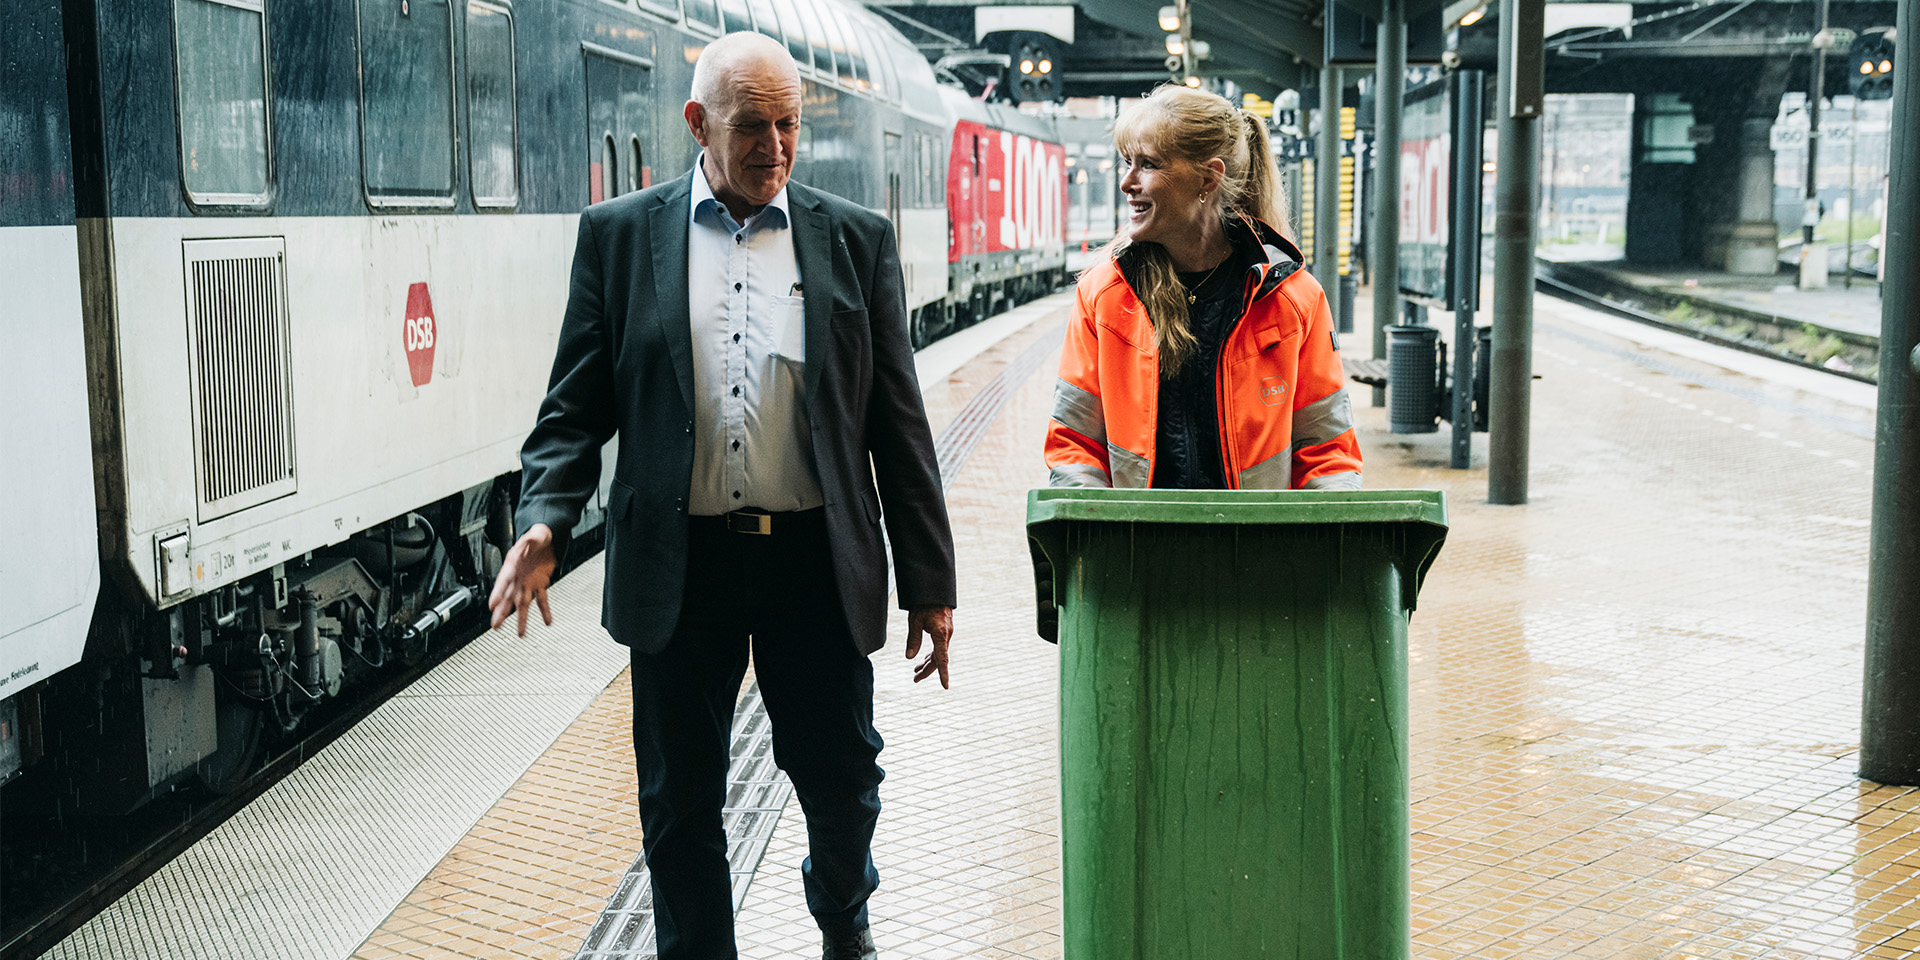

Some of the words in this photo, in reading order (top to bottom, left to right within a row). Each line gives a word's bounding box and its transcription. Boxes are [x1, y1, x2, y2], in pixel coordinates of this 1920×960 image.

[1000, 131, 1062, 249] 1000
[407, 317, 434, 352] DSB
[1262, 384, 1285, 398] DSB
